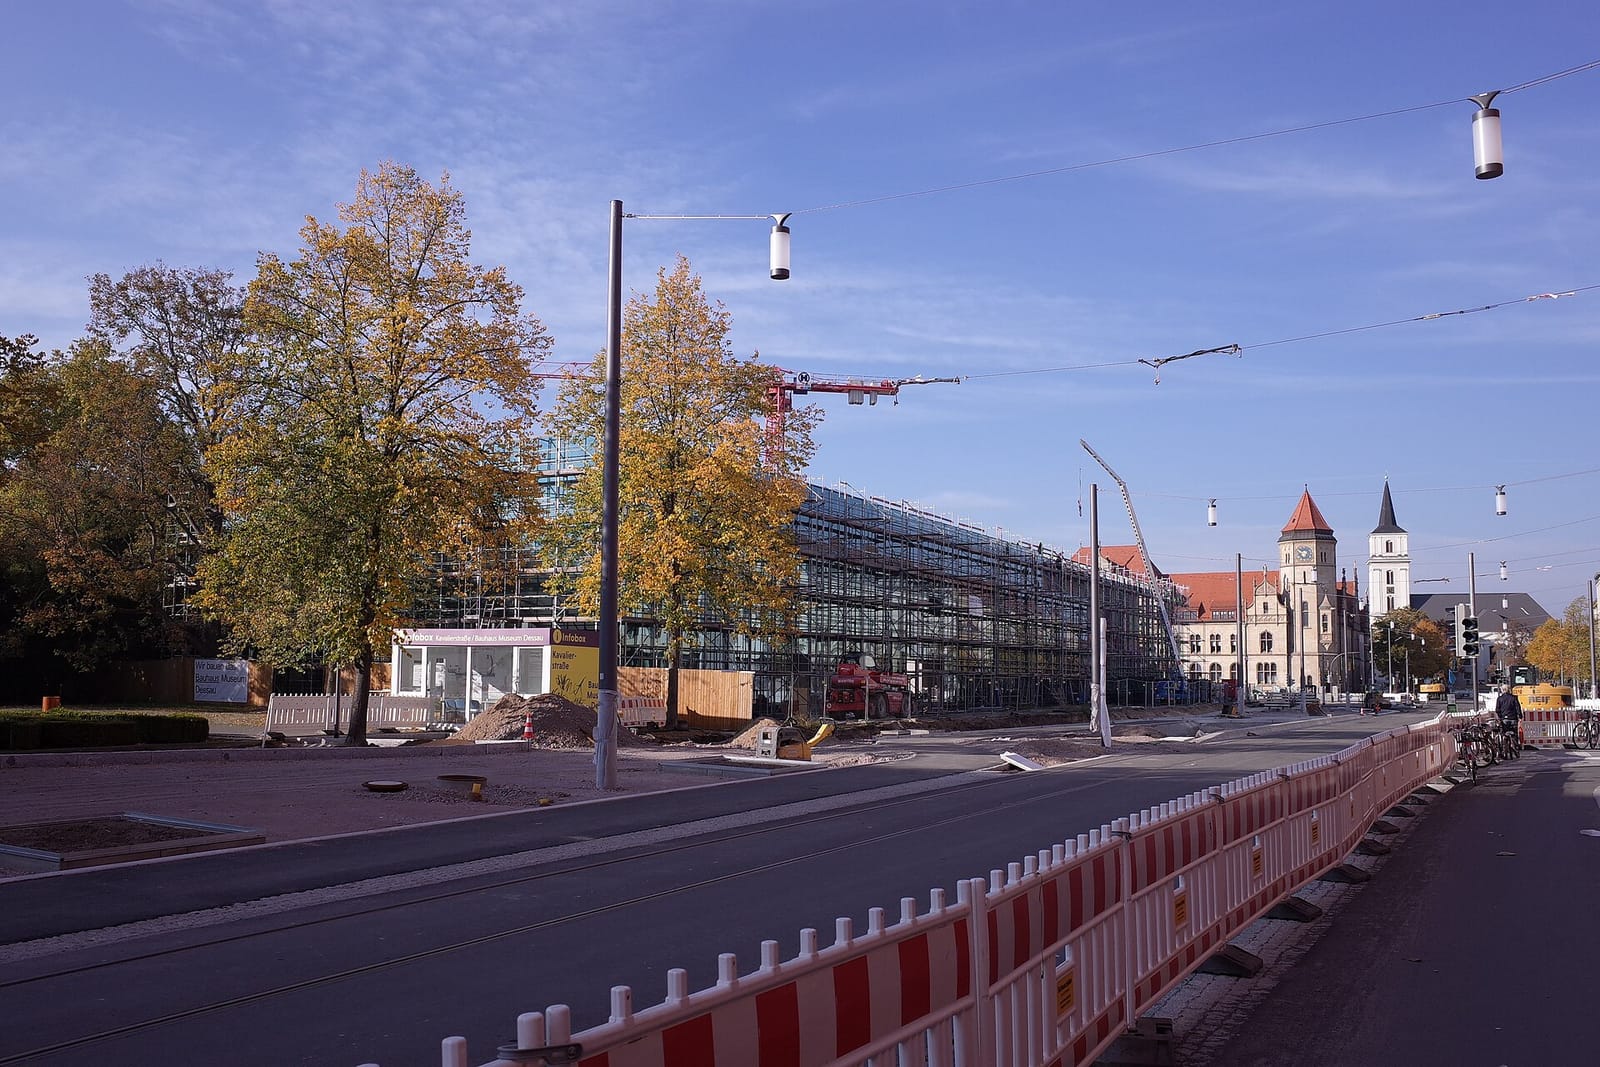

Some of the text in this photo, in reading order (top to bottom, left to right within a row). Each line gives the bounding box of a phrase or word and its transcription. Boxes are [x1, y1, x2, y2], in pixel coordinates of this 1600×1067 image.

[562, 633, 586, 643] Infobox
[196, 661, 205, 669] Wir
[206, 661, 224, 670] bauen
[552, 662, 569, 670] straße
[196, 673, 246, 682] Bauhaus Museum
[196, 685, 216, 694] Dessau
